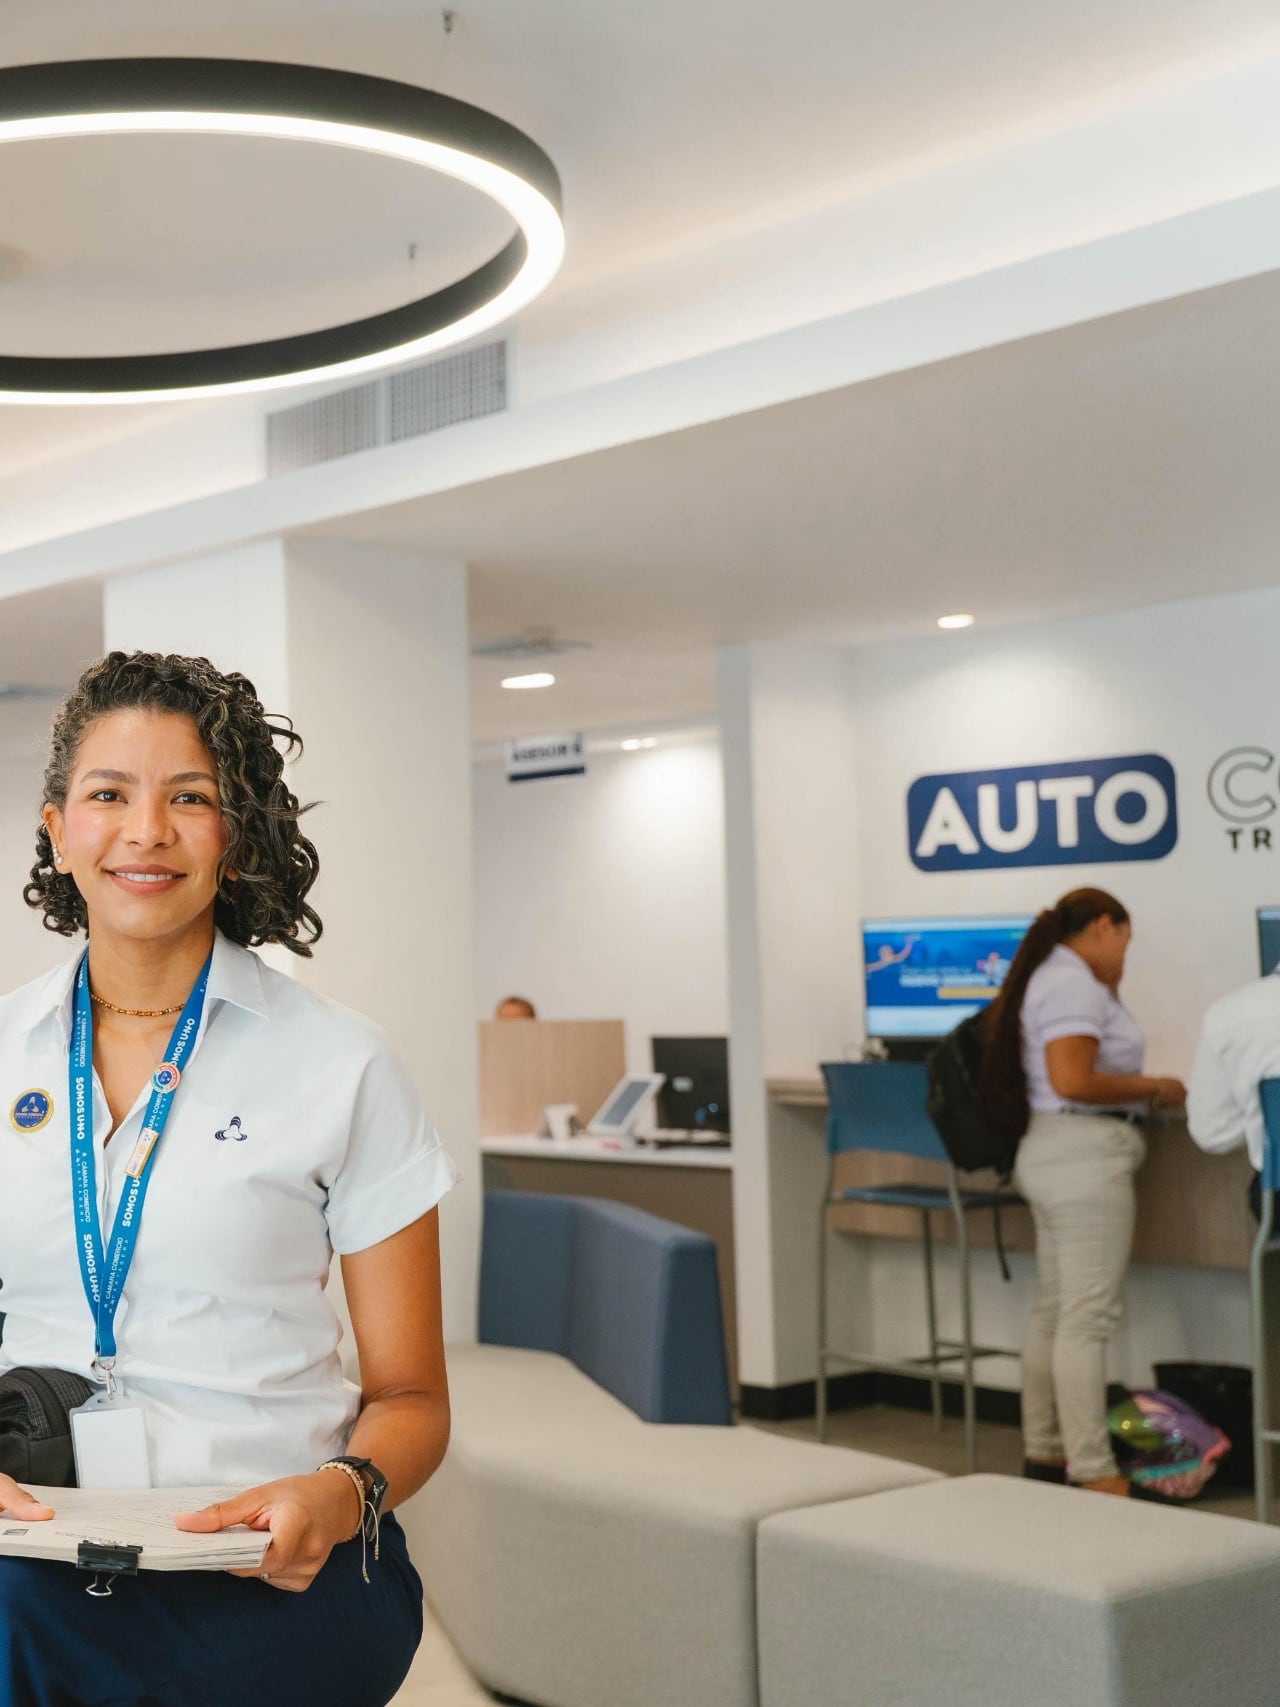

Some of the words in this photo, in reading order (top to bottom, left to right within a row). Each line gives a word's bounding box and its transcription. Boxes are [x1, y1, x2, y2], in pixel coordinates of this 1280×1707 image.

[916, 770, 1169, 857] AUTO
[1207, 746, 1280, 823] C
[1224, 827, 1272, 851] TR
[171, 1041, 186, 1066] OMOS
[76, 1076, 85, 1114] SOMOS
[83, 1188, 91, 1223] COMERCIO
[122, 1188, 138, 1227] SOMOS
[83, 1233, 97, 1274] SOMOS
[111, 1236, 124, 1271] COMERCIO
